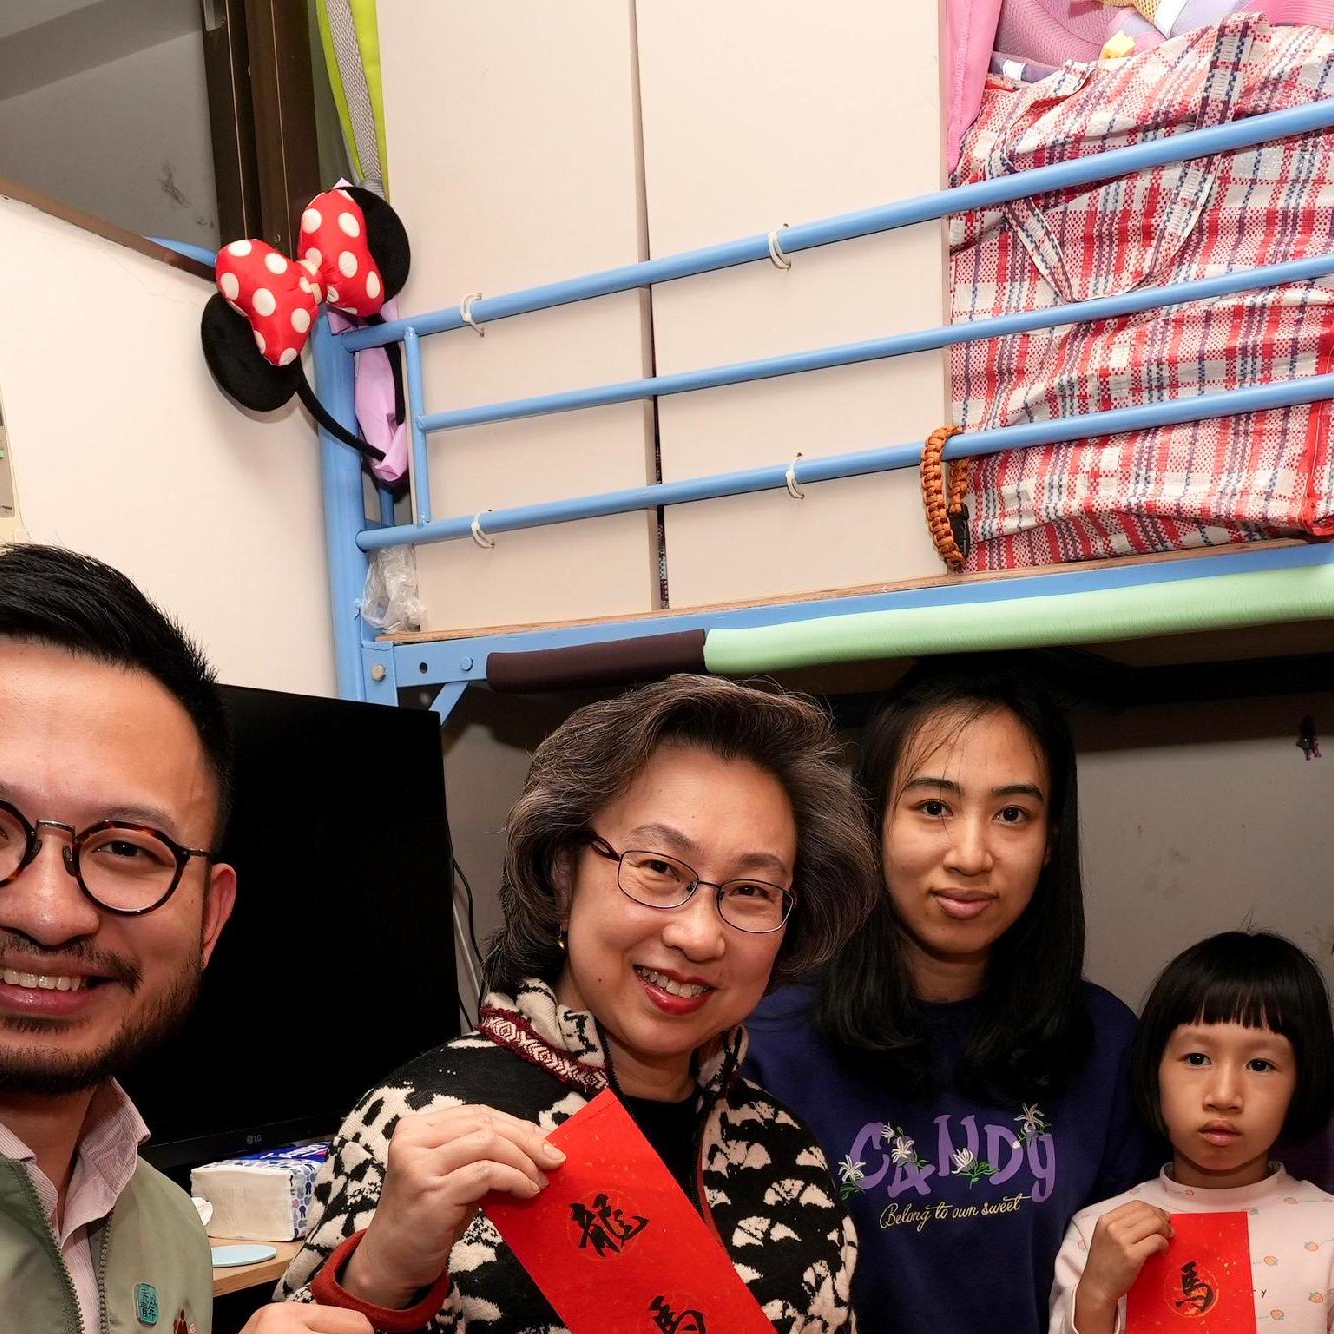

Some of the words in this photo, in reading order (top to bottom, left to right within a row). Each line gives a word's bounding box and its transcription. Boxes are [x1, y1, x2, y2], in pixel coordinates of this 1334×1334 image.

[879, 1203, 931, 1232] Belong
[926, 1202, 953, 1219] to
[981, 1193, 1031, 1217] sweet
